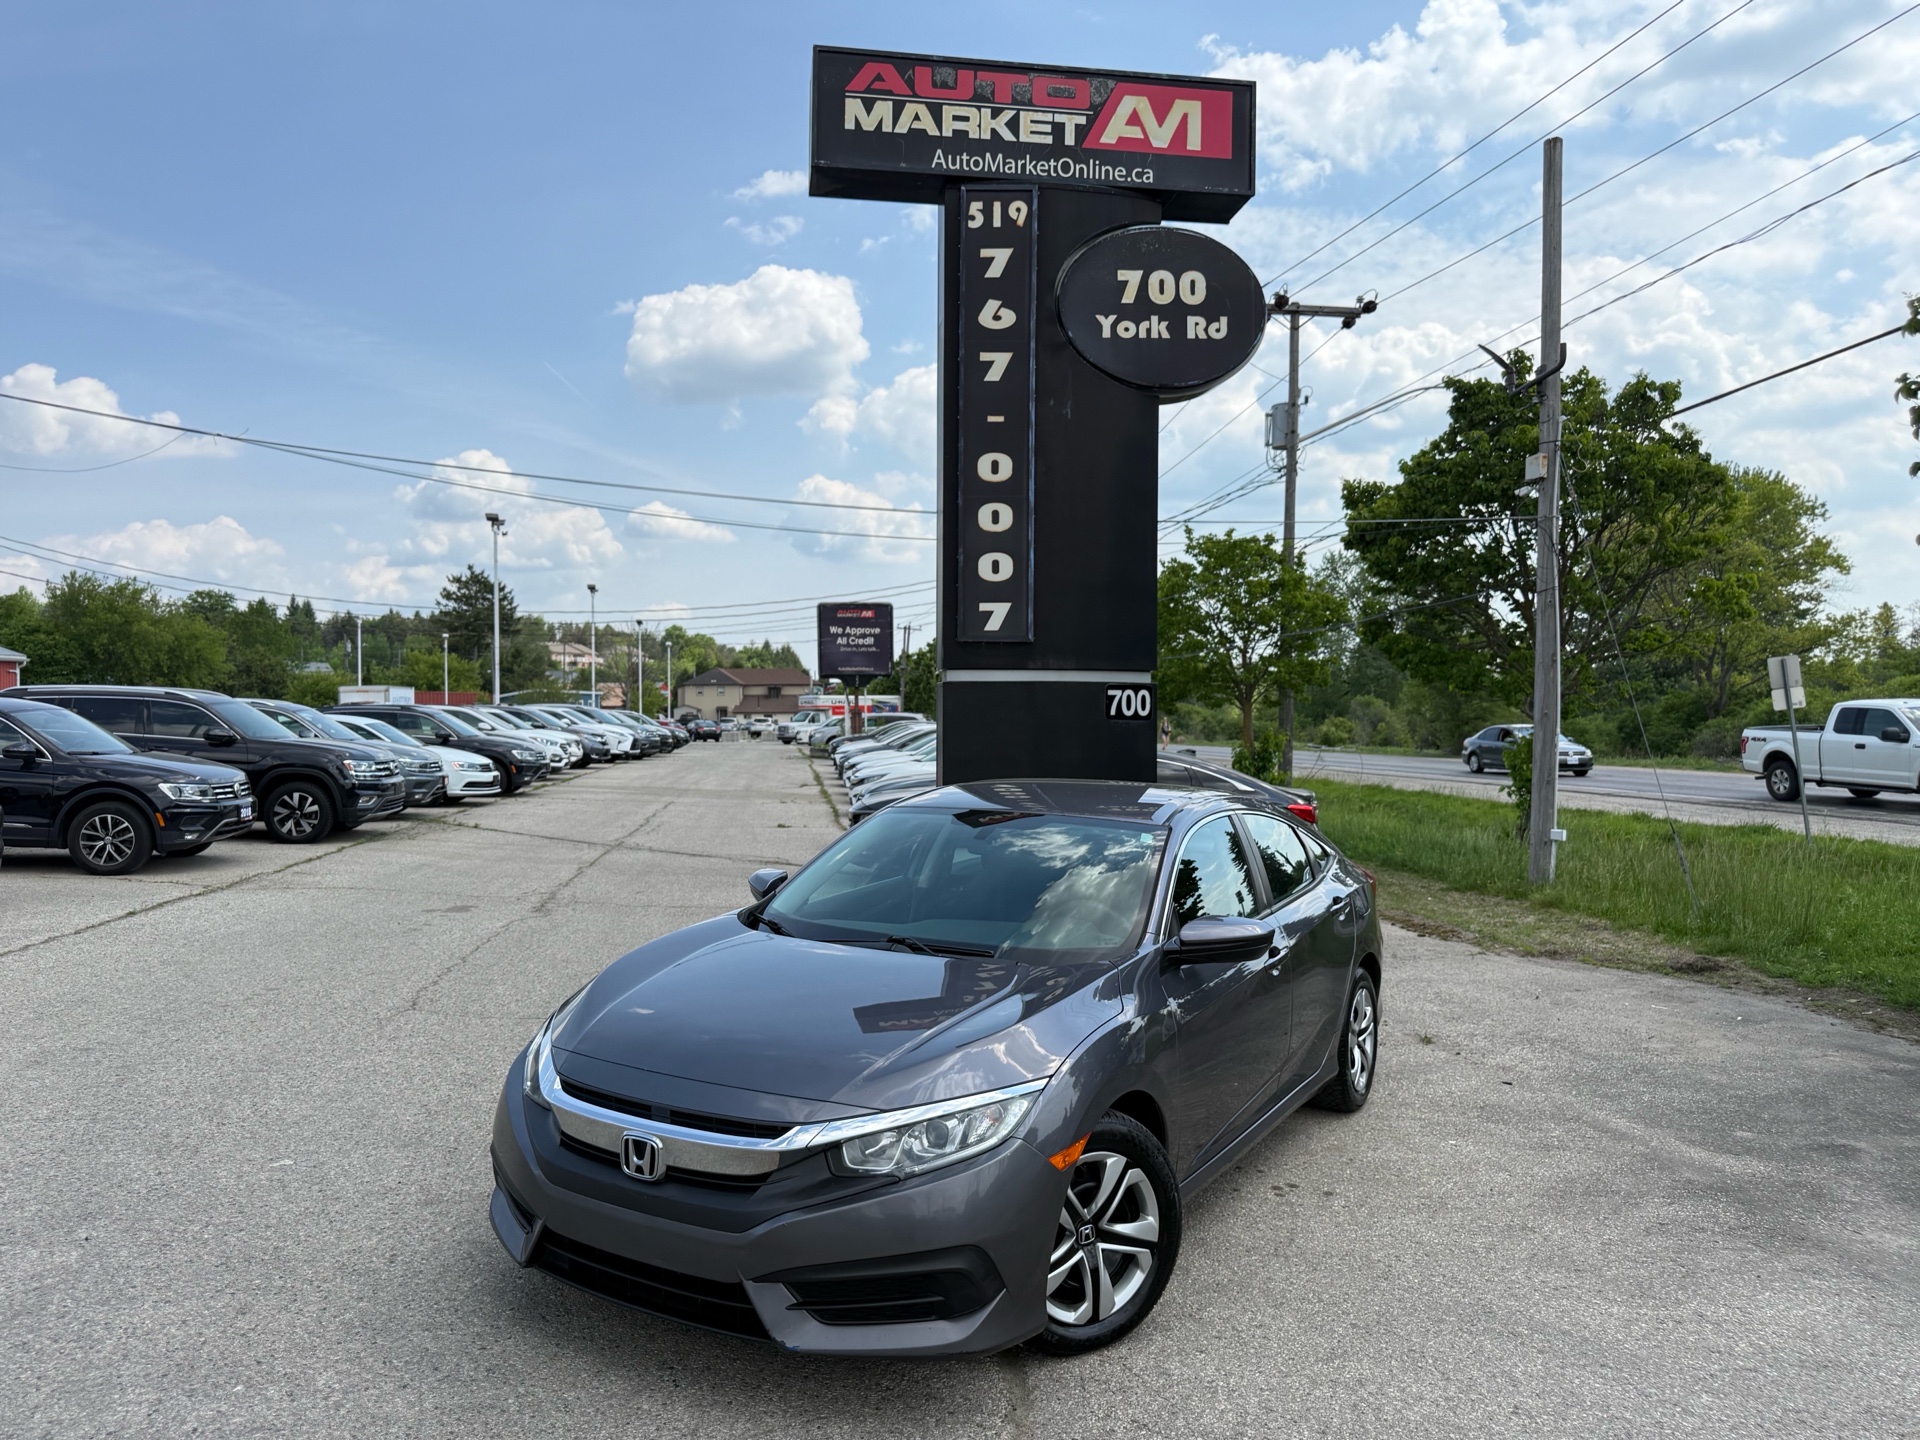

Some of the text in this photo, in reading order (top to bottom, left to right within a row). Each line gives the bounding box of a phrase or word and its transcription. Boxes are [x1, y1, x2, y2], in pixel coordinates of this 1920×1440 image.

[845, 62, 1091, 110] AUTO
[844, 97, 1087, 146] MARKET
[1099, 94, 1201, 151] AM
[931, 149, 1154, 183] AutoMarketOnline.ca
[967, 200, 1028, 229] 519
[1117, 269, 1207, 305] 700
[1095, 314, 1228, 340] York Rd
[829, 625, 881, 636] We Approve
[836, 636, 874, 645] All Credit
[1107, 689, 1151, 717] 700
